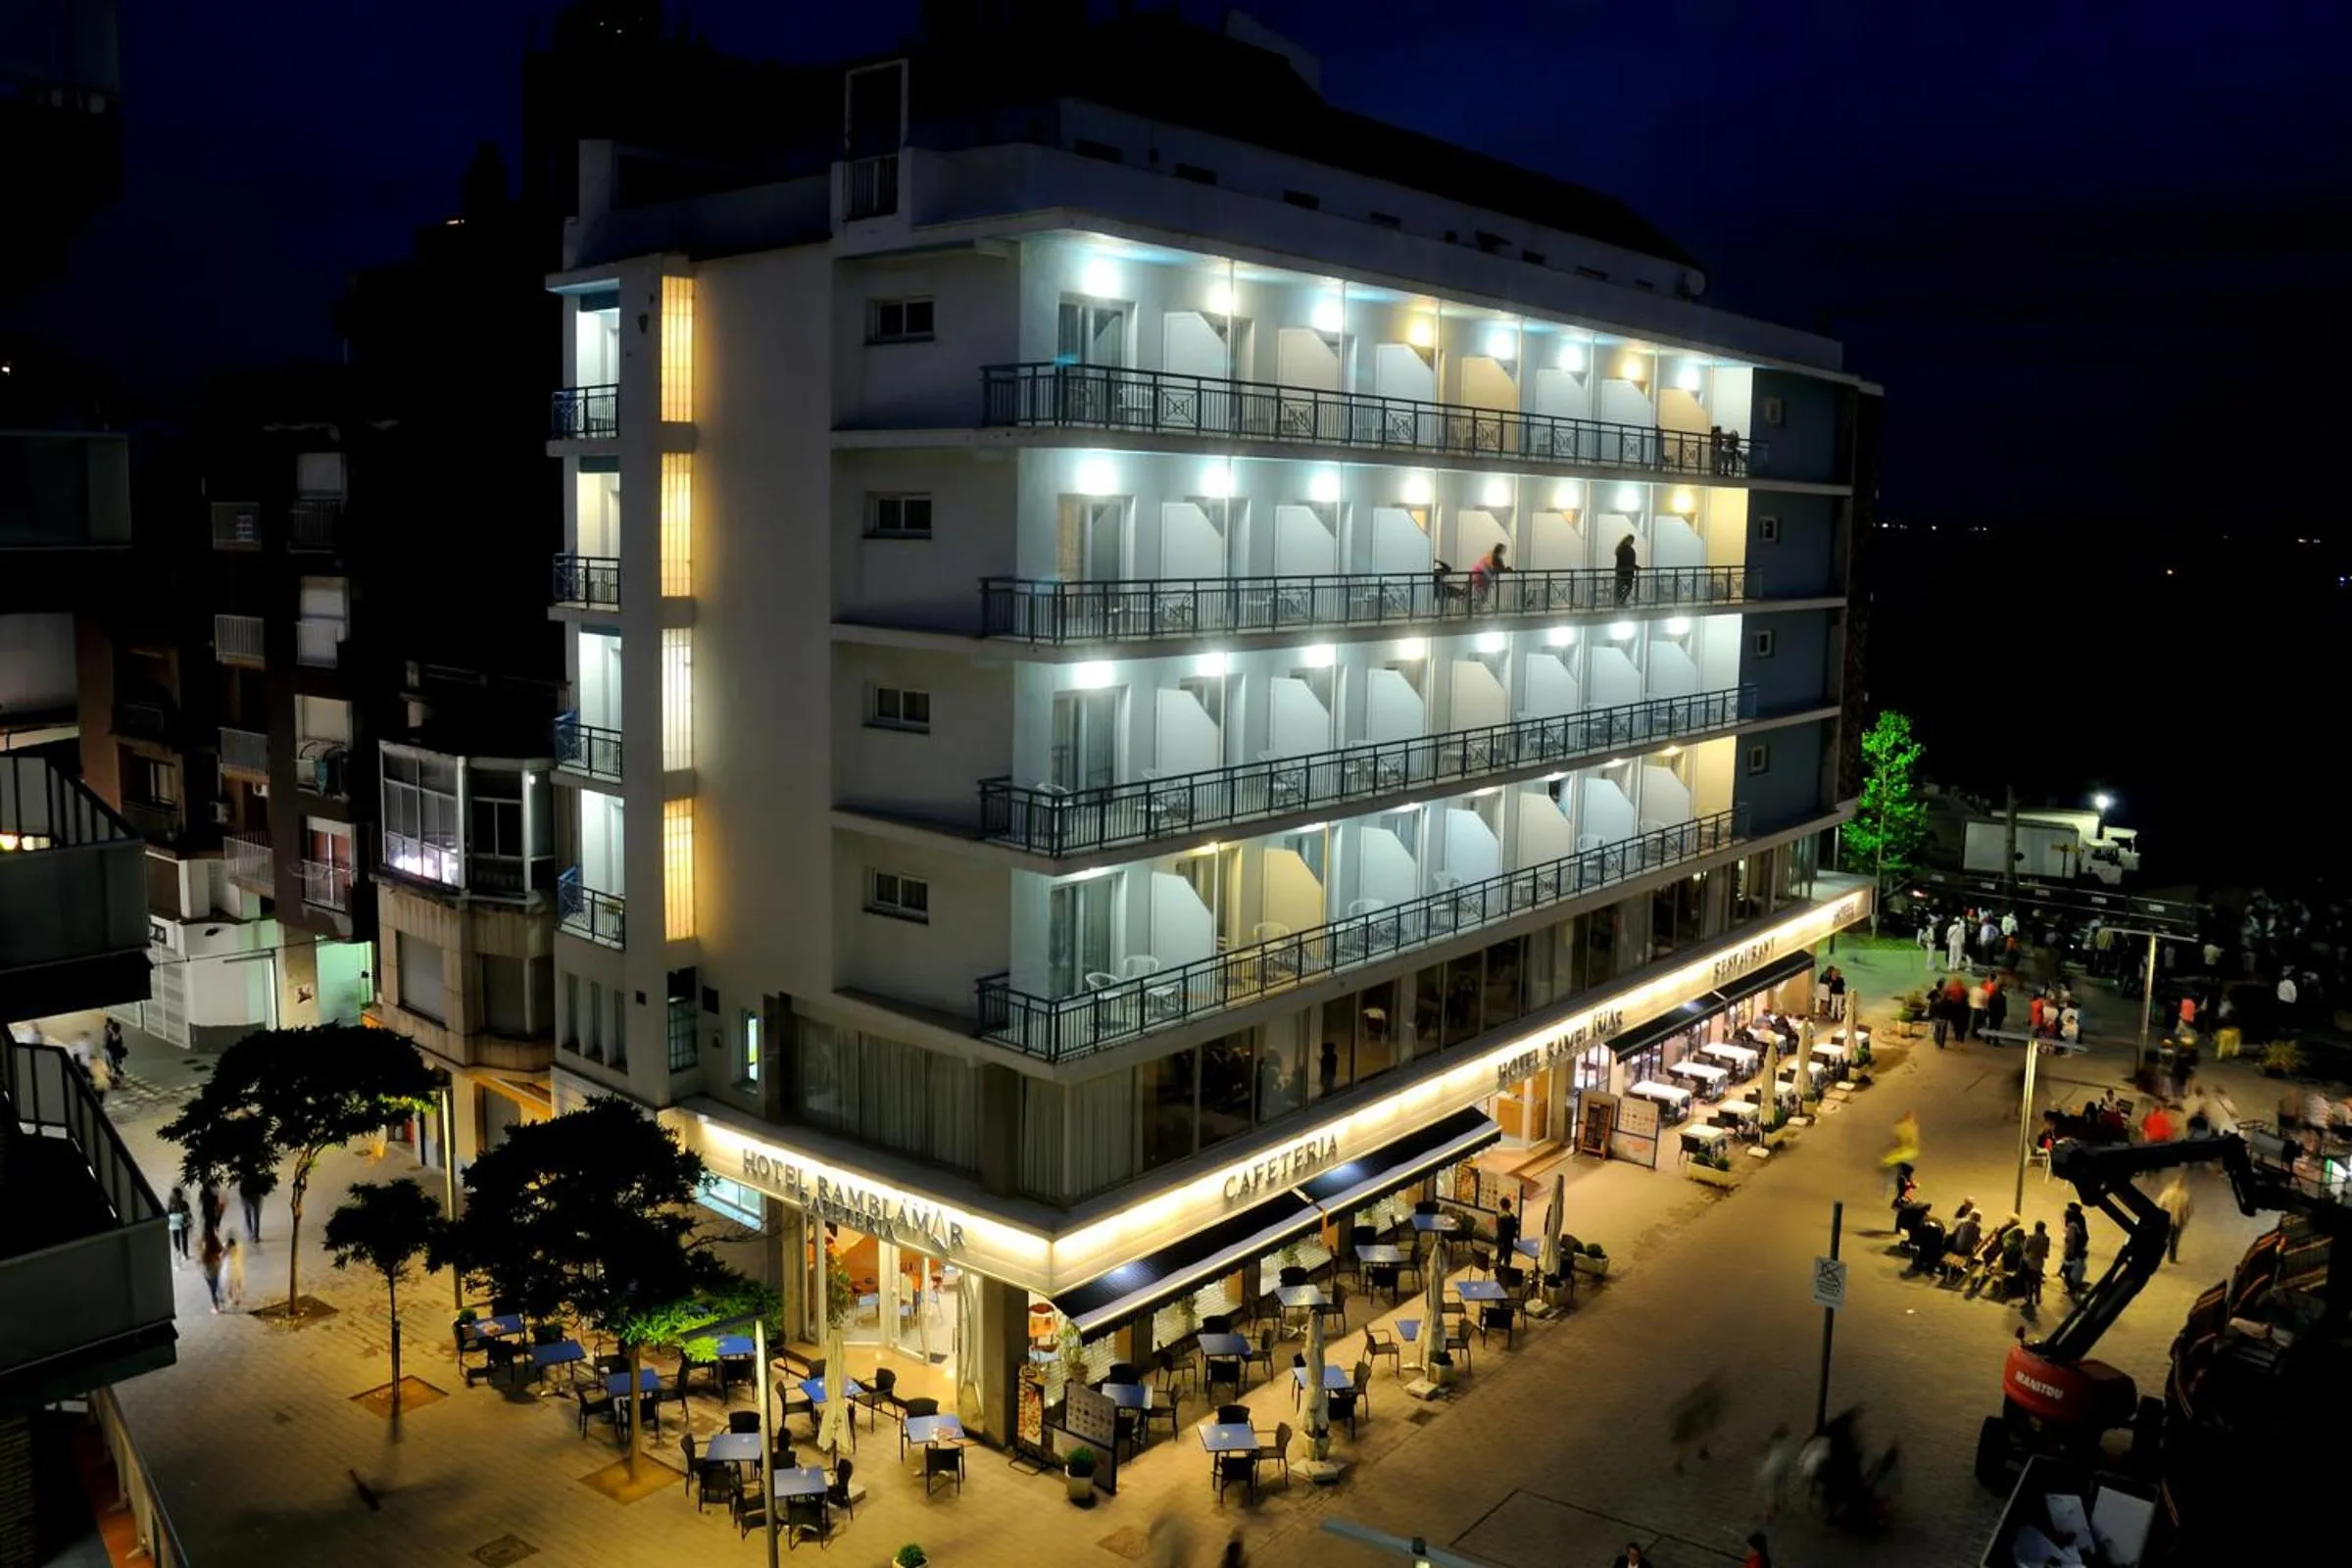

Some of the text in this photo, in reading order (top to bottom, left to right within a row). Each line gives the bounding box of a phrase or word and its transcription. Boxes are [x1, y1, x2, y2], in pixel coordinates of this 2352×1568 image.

[742, 1148, 965, 1250] HOTEL RAMBLAMAR
[1224, 1133, 1339, 1199] CAFETERIA
[2014, 1370, 2065, 1399] MANITOU
